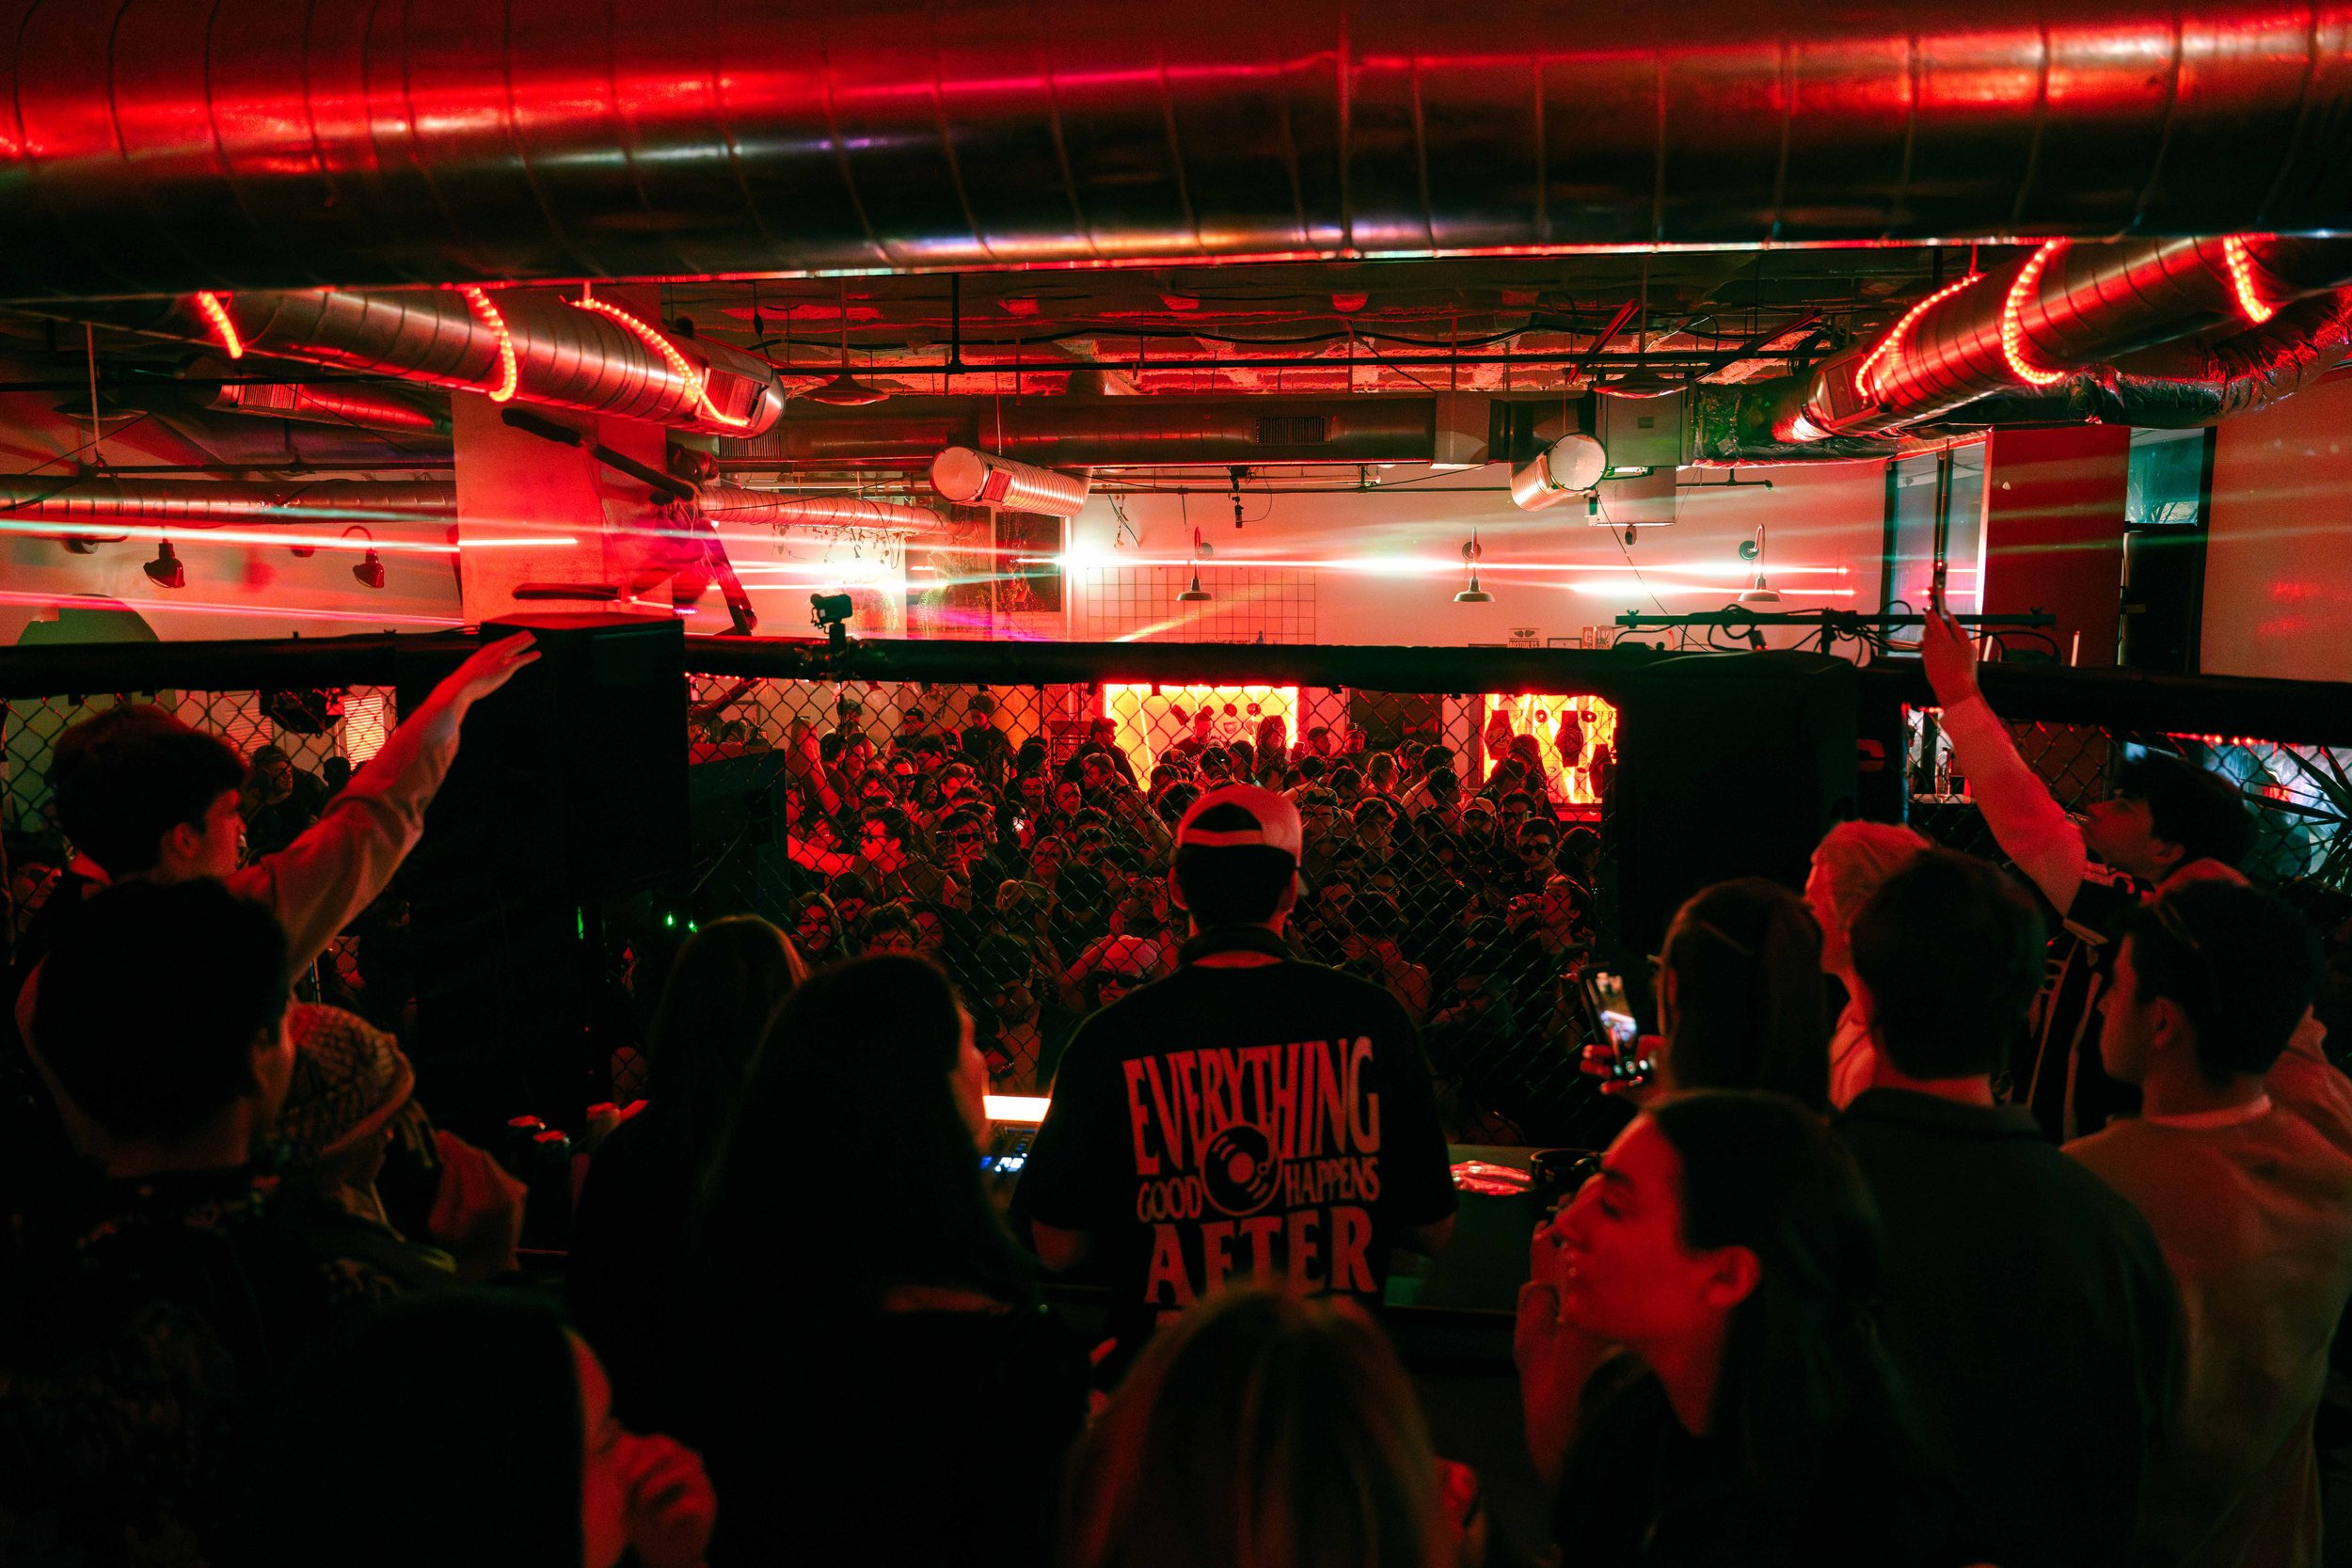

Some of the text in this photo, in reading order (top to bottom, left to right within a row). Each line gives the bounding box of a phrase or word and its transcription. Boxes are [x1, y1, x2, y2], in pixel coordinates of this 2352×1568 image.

[1121, 1035, 1382, 1176] EVERYTHING
[1136, 1155, 1383, 1224] GOOD HAPPENS
[1144, 1205, 1378, 1307] AFTER
